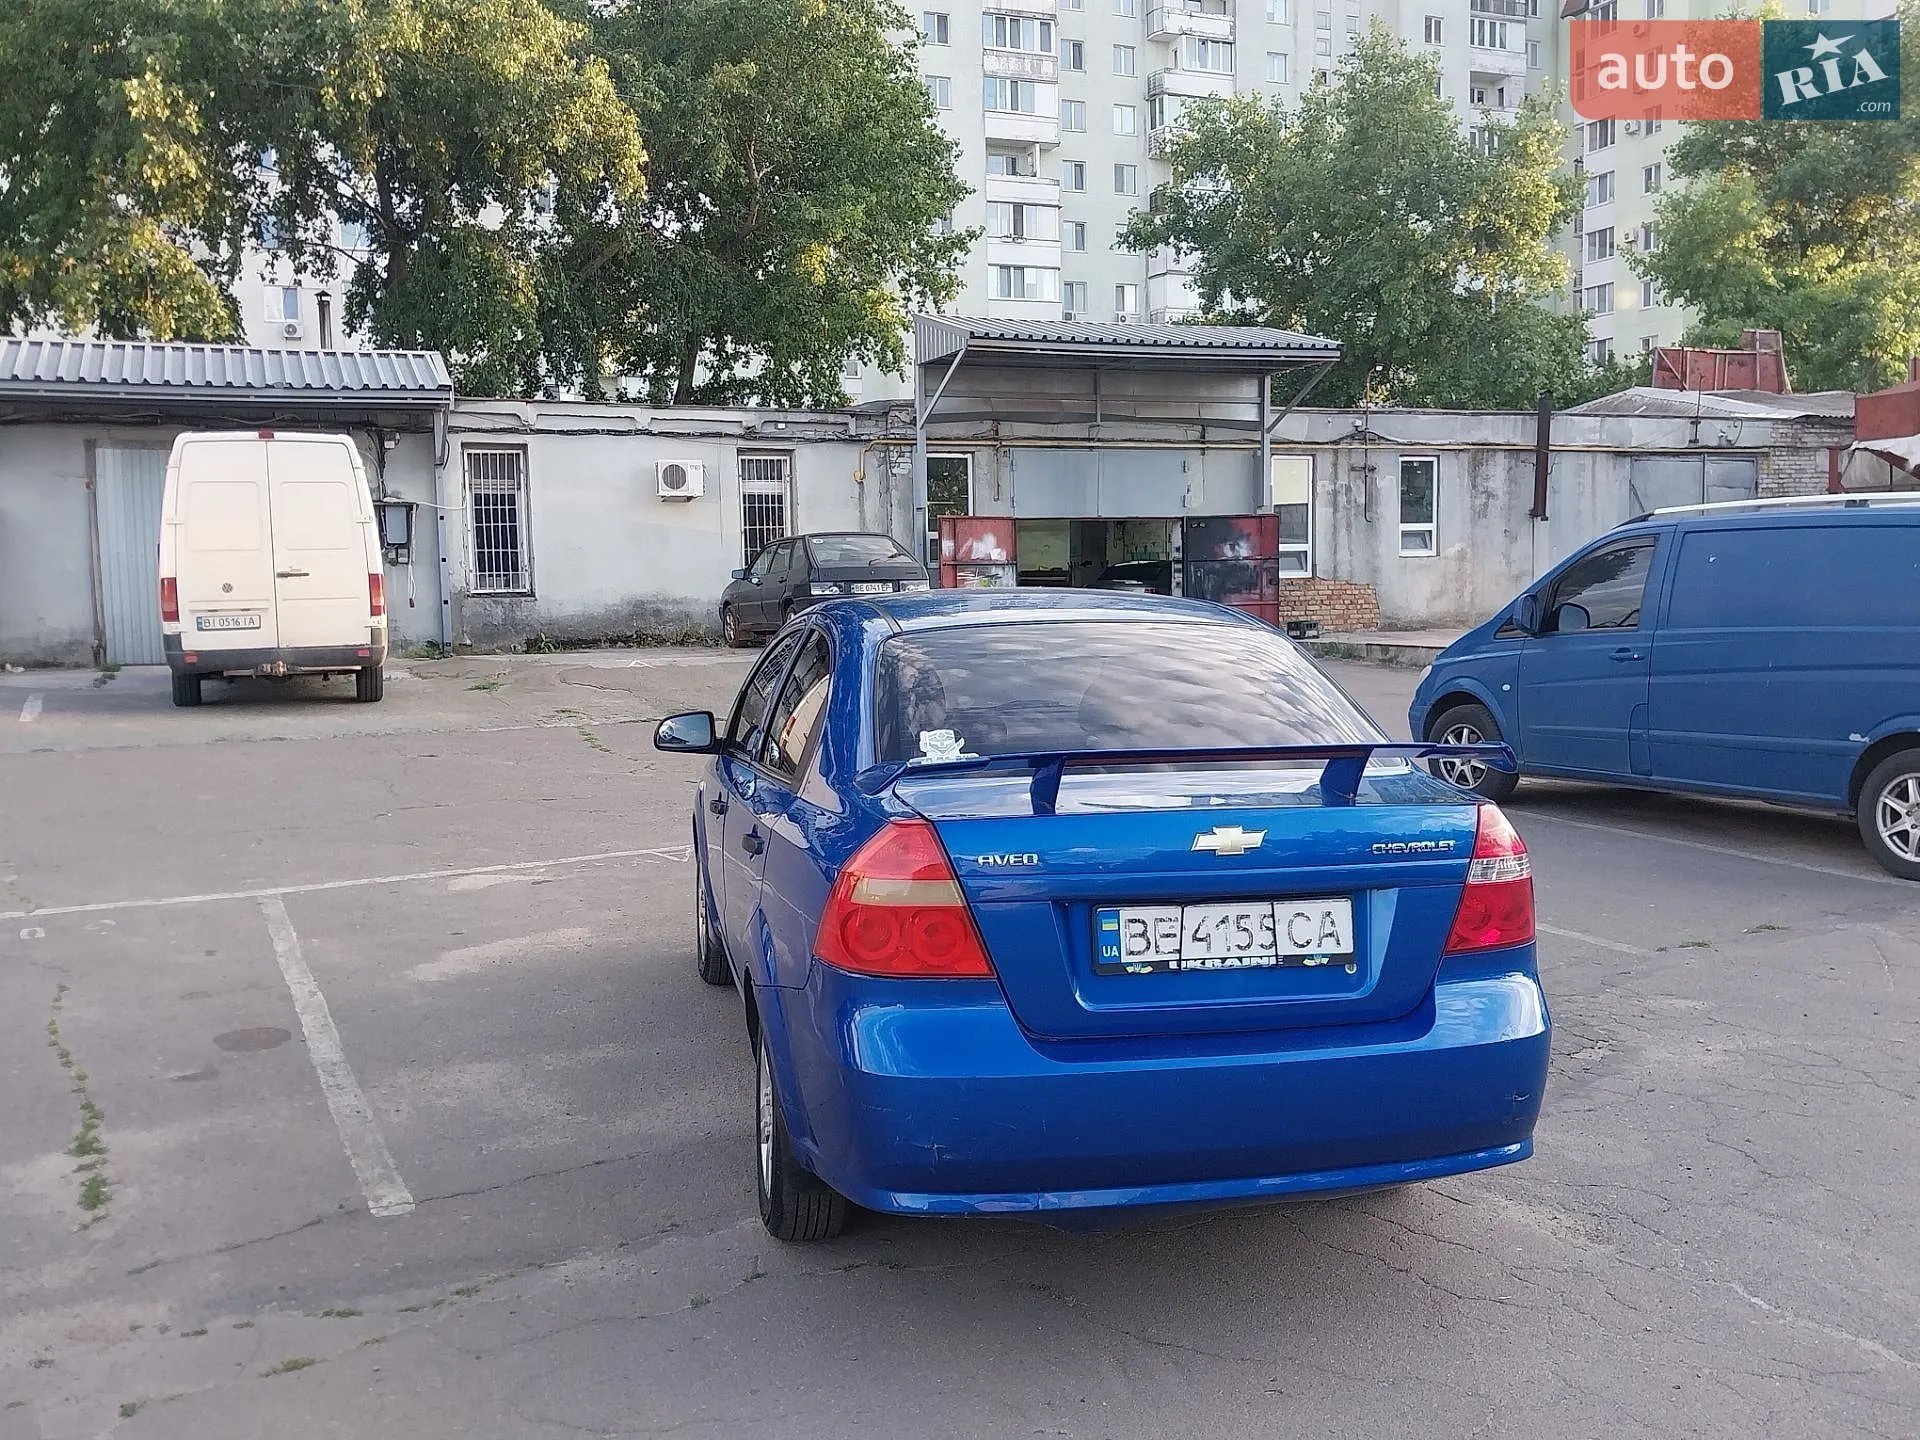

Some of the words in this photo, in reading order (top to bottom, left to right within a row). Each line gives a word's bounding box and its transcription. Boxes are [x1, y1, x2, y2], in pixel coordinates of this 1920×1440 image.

[203, 618, 216, 628] BI
[219, 617, 241, 627] 0516
[243, 616, 255, 626] IA
[1372, 840, 1456, 855] CHEVROLET
[977, 853, 1039, 868] AVEO
[1124, 916, 1180, 956] BE
[1191, 913, 1275, 953] 4155
[1287, 910, 1342, 949] CA
[1102, 945, 1119, 958] UA
[1168, 956, 1284, 971] UKRAINE
